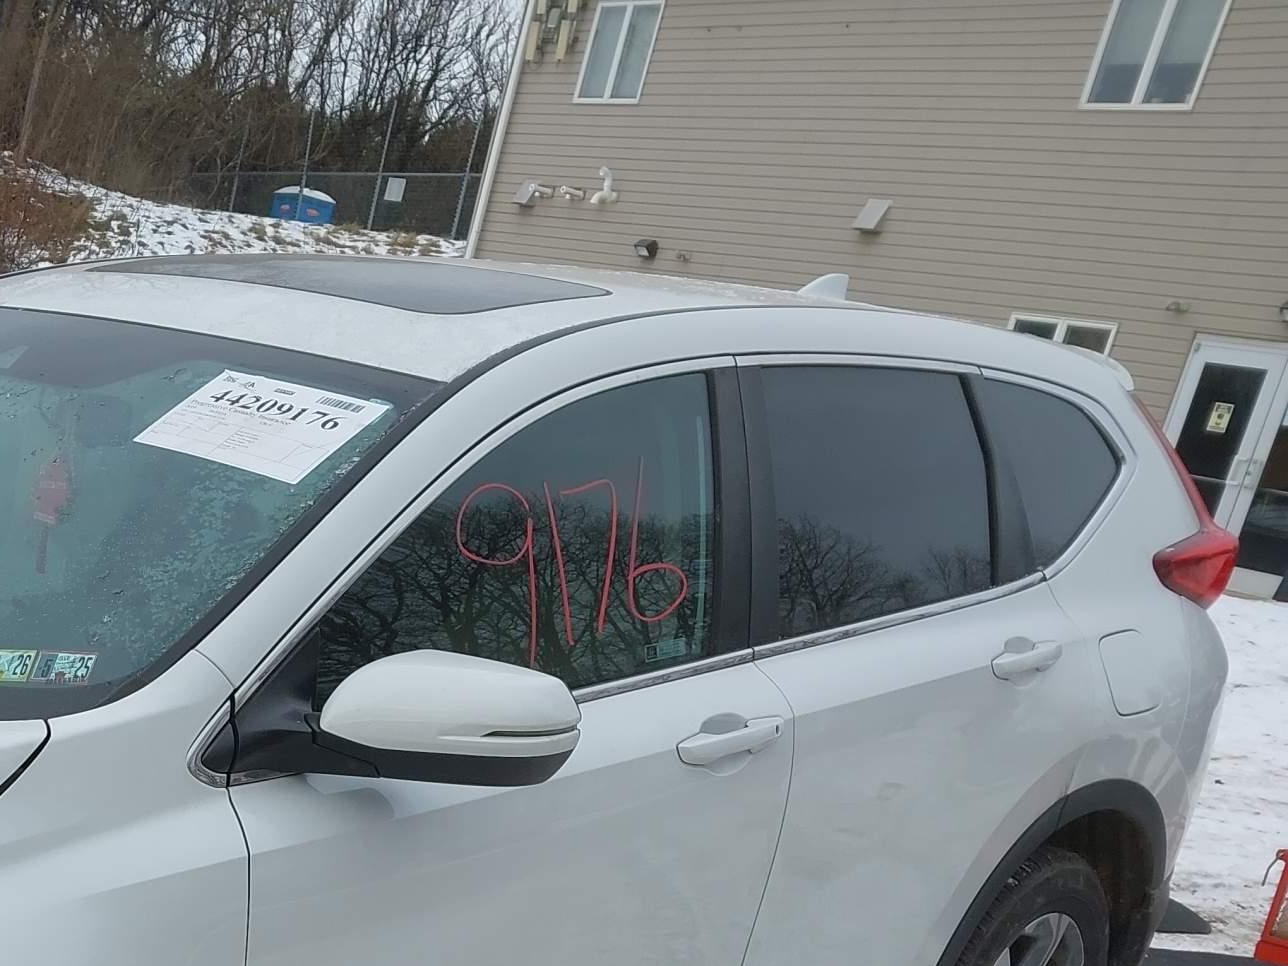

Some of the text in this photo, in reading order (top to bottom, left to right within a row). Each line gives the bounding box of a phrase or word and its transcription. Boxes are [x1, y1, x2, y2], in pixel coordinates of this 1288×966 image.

[209, 389, 342, 431] 44209176
[456, 456, 688, 668] 9176
[13, 655, 32, 676] 26
[74, 656, 94, 678] 25
